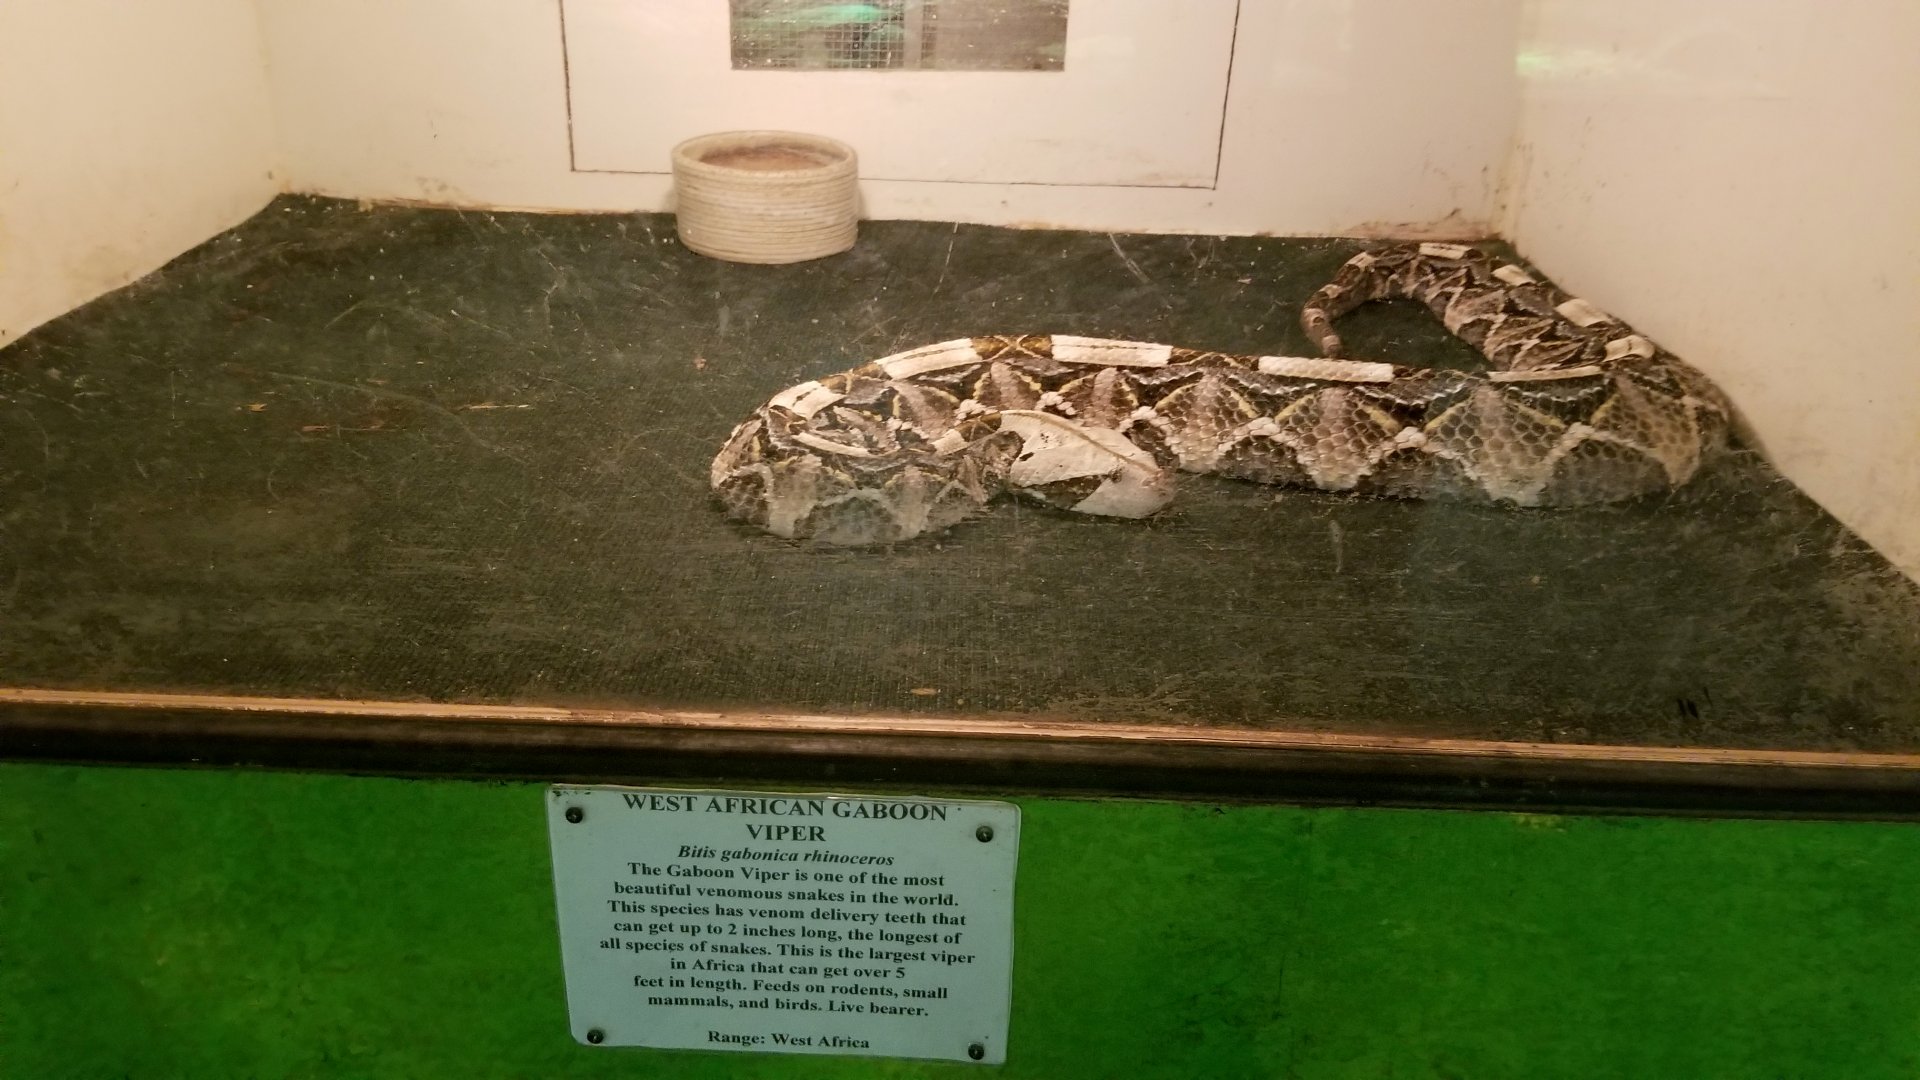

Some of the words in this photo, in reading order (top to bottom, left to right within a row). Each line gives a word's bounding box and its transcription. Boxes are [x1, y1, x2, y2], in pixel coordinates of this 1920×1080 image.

[622, 793, 698, 813] WEST
[705, 796, 825, 818] AFRICAN
[832, 801, 948, 822] GABOON
[745, 823, 827, 843] VIPER
[677, 845, 717, 858] Bitis
[720, 847, 799, 863] gabonica
[803, 849, 895, 866] rhinoceros
[627, 862, 662, 876] The
[666, 864, 734, 879] Gaboon
[740, 866, 790, 884] Viper
[795, 868, 808, 881] is
[813, 872, 844, 883] one
[848, 871, 868, 884] of
[871, 872, 898, 886] the
[903, 875, 945, 887] most
[614, 881, 691, 896] beautiful
[696, 887, 783, 900] venomous
[787, 888, 845, 902] snakes
[850, 890, 866, 903] in
[872, 891, 899, 904] the
[903, 893, 959, 907] world.
[607, 900, 646, 914] This
[650, 902, 710, 918] species
[715, 903, 744, 917] has
[748, 909, 805, 919] venom
[810, 907, 879, 926] delivery
[885, 912, 926, 924] teeth
[932, 912, 966, 926] that
[613, 922, 643, 932] can
[648, 922, 674, 936] get
[679, 924, 701, 937] up
[706, 923, 723, 935] to
[728, 923, 737, 935] 2
[743, 923, 796, 938] inches
[801, 925, 843, 943] long,
[847, 928, 874, 941] the
[879, 928, 938, 946] longest
[943, 932, 963, 945] of
[600, 937, 621, 950] all
[625, 939, 685, 954] species
[689, 940, 708, 953] of
[710, 942, 772, 956] snakes.
[776, 943, 814, 957] This
[819, 945, 833, 958] is
[837, 946, 864, 959] the
[869, 947, 926, 964] largest
[930, 950, 976, 966] viper
[670, 957, 687, 970] in
[692, 958, 745, 973] Africa
[750, 961, 784, 974] that
[789, 966, 818, 975] can
[823, 966, 848, 979] get
[853, 968, 891, 978] over
[895, 967, 905, 979] 5
[634, 975, 664, 988] feet
[669, 975, 685, 988] in
[690, 976, 747, 993] length.
[753, 979, 800, 993] Feeds
[805, 984, 825, 993] on
[831, 983, 899, 999] rodents,
[902, 987, 948, 999] small
[648, 995, 734, 1010] mammals,
[738, 997, 769, 1009] and
[775, 998, 822, 1011] birds.
[828, 1000, 865, 1013] Live
[870, 1001, 929, 1017] bearer.
[707, 1030, 766, 1047] Range:
[771, 1032, 814, 1048] West
[817, 1034, 870, 1049] Africa
